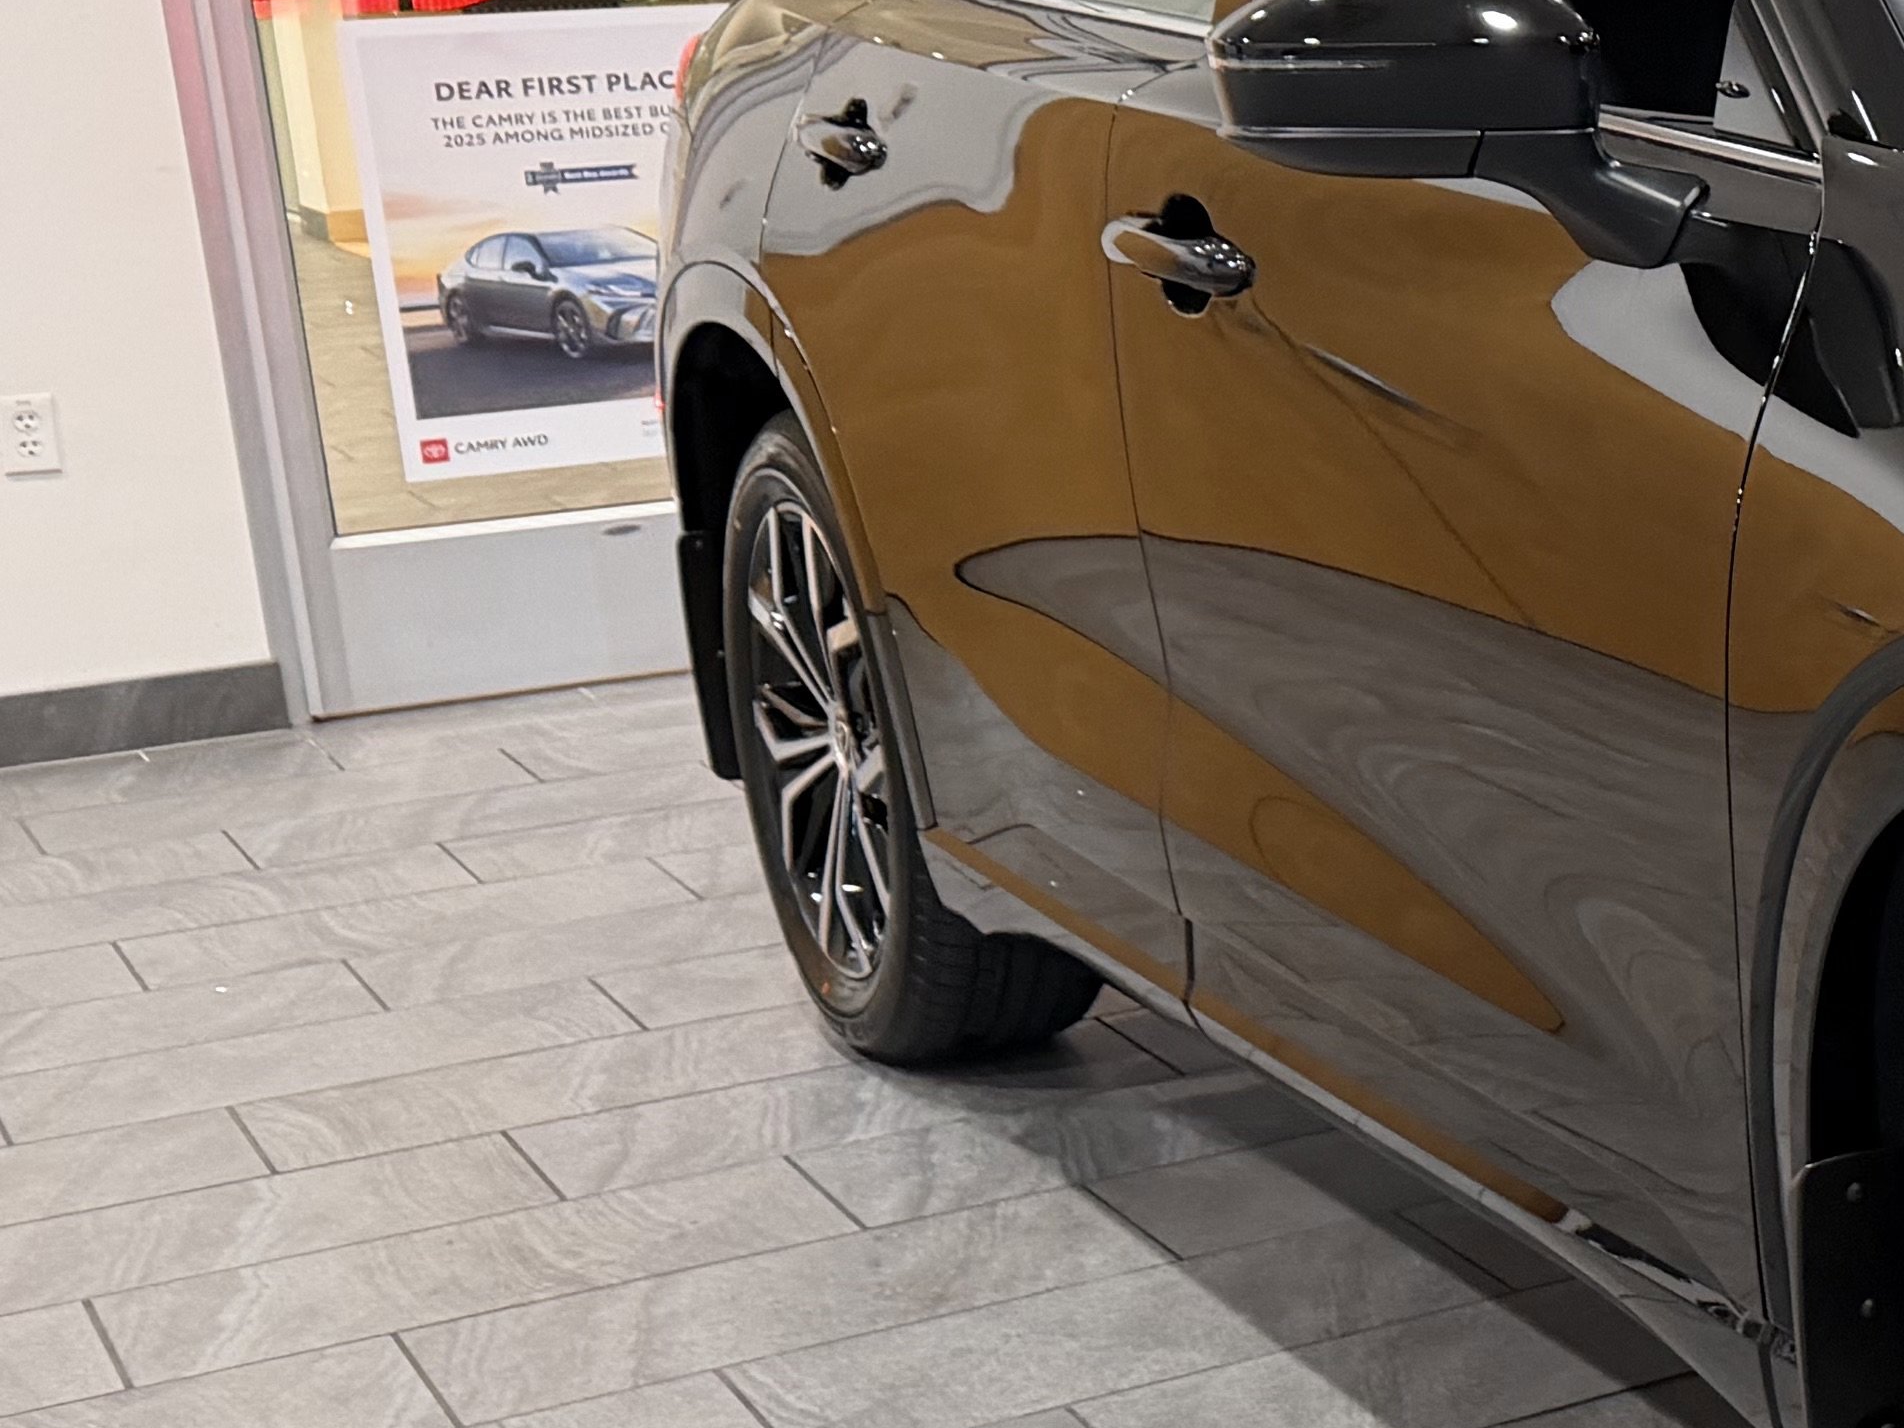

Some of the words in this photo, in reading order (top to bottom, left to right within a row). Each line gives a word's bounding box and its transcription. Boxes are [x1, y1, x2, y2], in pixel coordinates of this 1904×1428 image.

[434, 78, 514, 102] DEAR
[522, 74, 597, 97] FIRST
[606, 71, 676, 93] PLAC
[430, 115, 466, 131] THE
[471, 110, 535, 129] CAMRY
[541, 111, 557, 125] IS
[562, 108, 596, 122] THE
[602, 105, 645, 121] BEST
[650, 104, 673, 118] BU
[443, 133, 487, 148] 2025
[492, 128, 564, 145] AMONG
[569, 122, 655, 140] MIDSIZED
[454, 439, 508, 454] CAMRY
[513, 434, 548, 448] AWD
